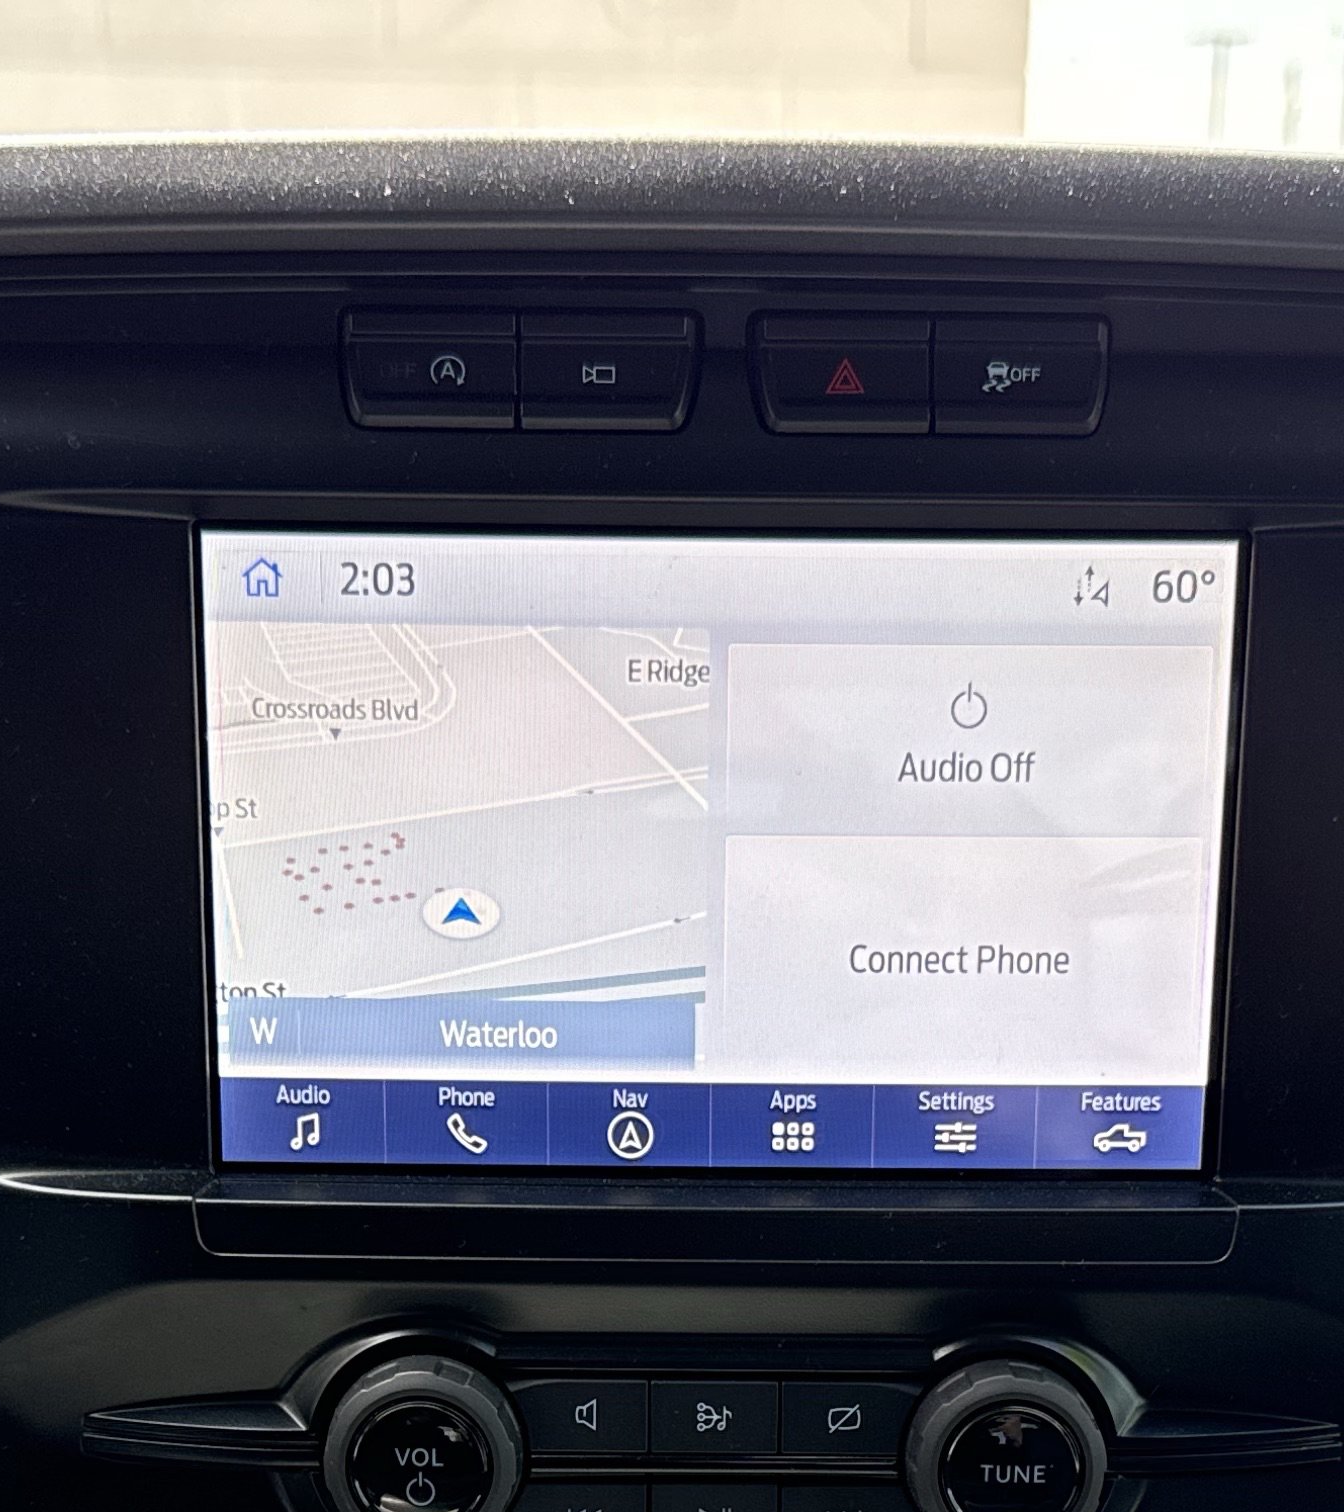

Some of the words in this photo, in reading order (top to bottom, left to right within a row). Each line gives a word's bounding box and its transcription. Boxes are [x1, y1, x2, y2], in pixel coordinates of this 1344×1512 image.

[1010, 367, 1041, 382] OFF
[340, 561, 415, 597] 2:03
[1152, 569, 1216, 604] 60°
[628, 659, 642, 682] E
[647, 658, 710, 687] Ridge
[251, 696, 367, 722] Crossroads
[371, 698, 418, 721] Blvd
[897, 752, 984, 783] Audio
[990, 751, 1036, 783] Off
[235, 798, 258, 819] St
[849, 944, 968, 974] Connect
[977, 944, 1070, 974] Phone
[262, 982, 286, 999] St
[249, 1016, 278, 1045] W
[439, 1019, 558, 1049] Waterloo
[276, 1084, 331, 1105] Audio
[438, 1086, 495, 1107] Phone
[613, 1088, 649, 1108] Nav
[769, 1089, 817, 1113] Apps
[917, 1090, 995, 1114] Settings
[1081, 1091, 1162, 1114] Features
[394, 1447, 444, 1467] VOL
[980, 1464, 1046, 1484] TUNE
